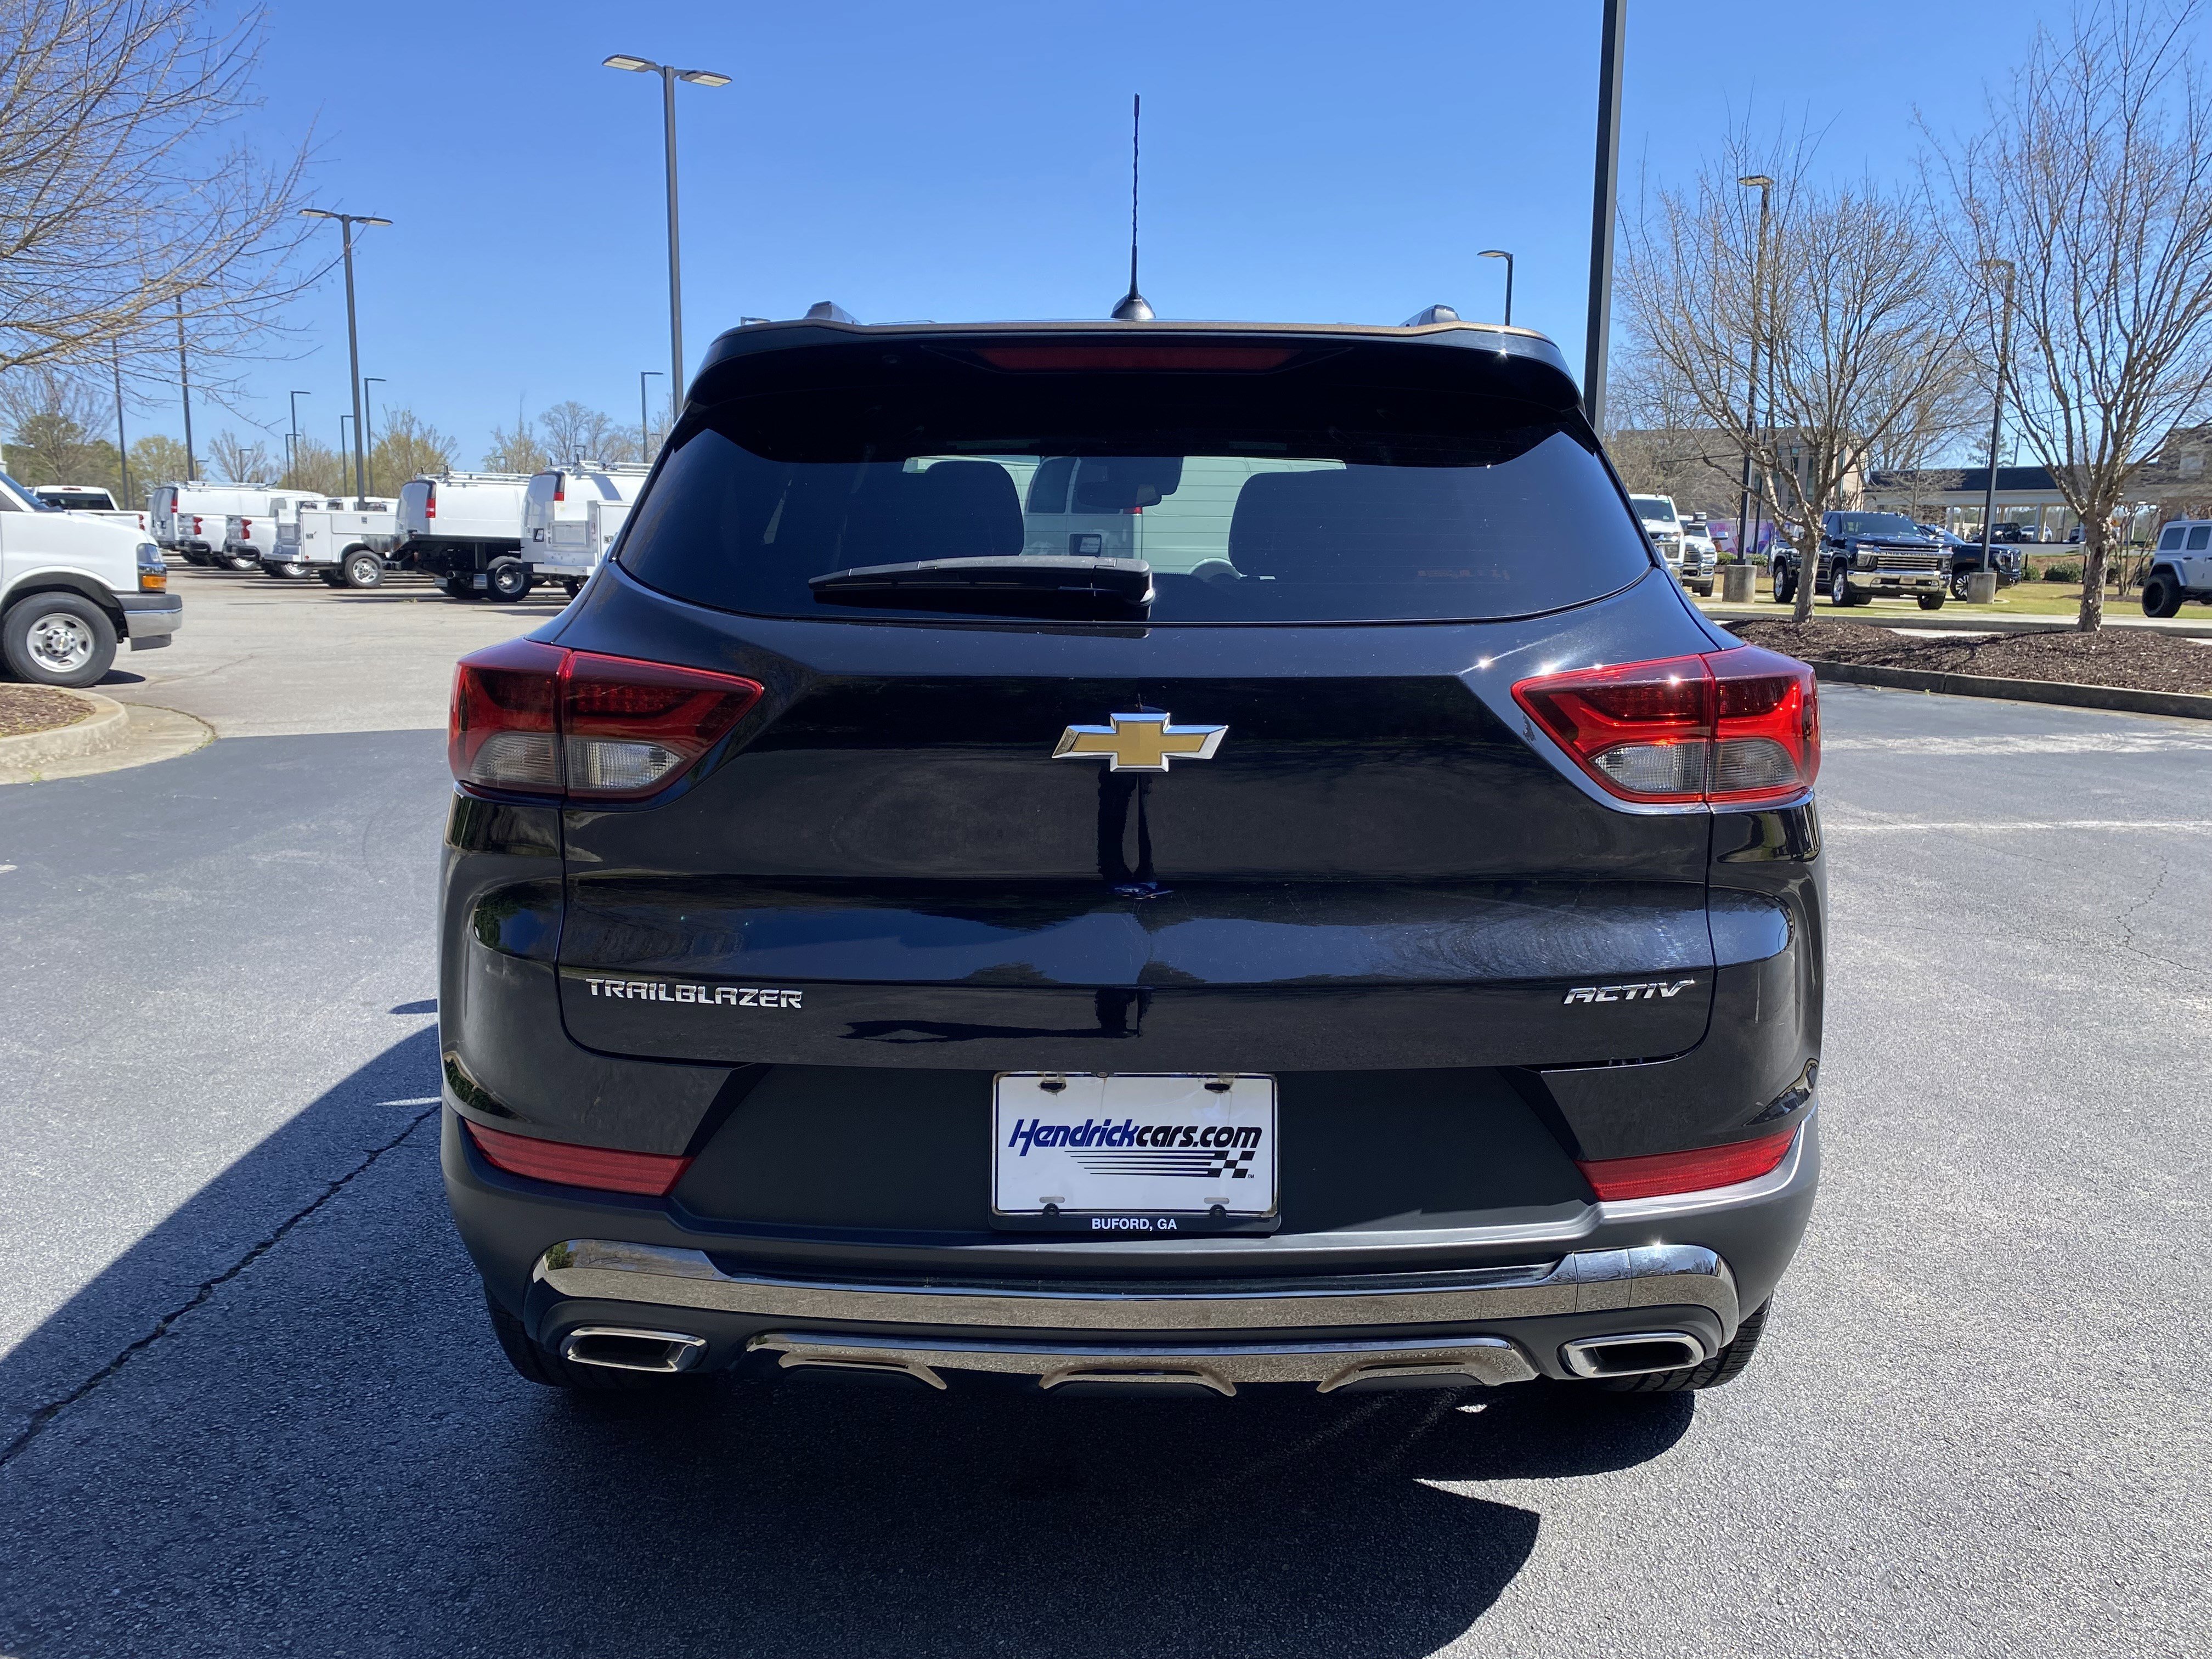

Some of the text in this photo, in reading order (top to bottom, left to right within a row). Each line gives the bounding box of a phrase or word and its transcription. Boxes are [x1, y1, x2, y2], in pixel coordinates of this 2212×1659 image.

[585, 978, 803, 1009] TRAILBLAZER
[1564, 979, 1695, 1005] ACTIV
[1007, 1118, 1262, 1156] Hendrickcars.com
[1091, 1218, 1177, 1232] BUFORD, GA
